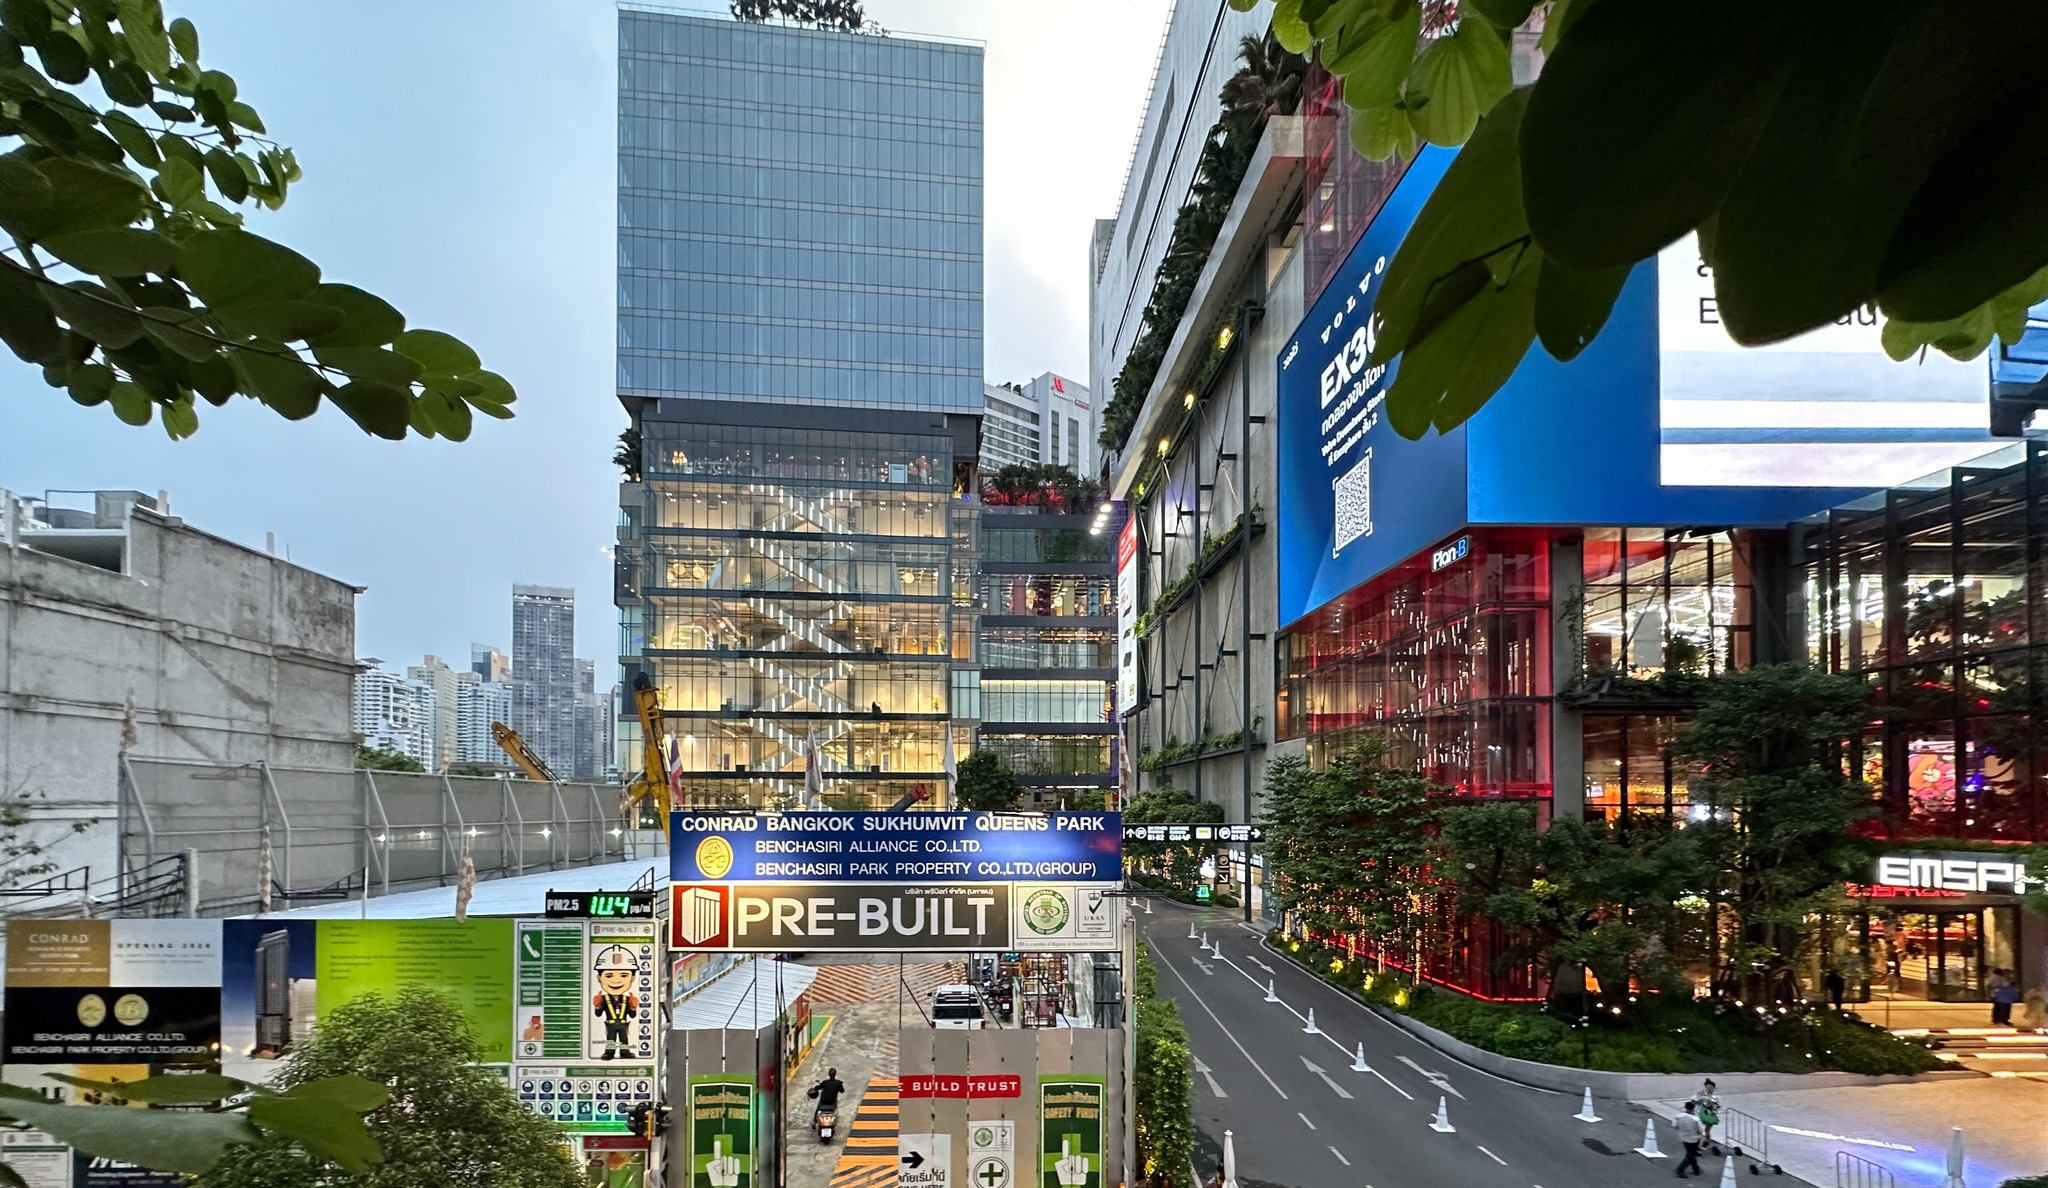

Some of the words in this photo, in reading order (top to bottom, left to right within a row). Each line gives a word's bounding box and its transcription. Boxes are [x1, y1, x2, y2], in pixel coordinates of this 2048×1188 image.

[1320, 255, 1386, 345] VOLVO
[1366, 388, 1386, 413] Store
[1371, 412, 1378, 426] 2
[681, 816, 758, 832] CONRAD
[766, 816, 855, 832] BANGKOK
[863, 816, 968, 832] SUKHUMVIT
[975, 815, 1049, 832] QUEENS
[1056, 816, 1105, 831] PARK
[755, 840, 842, 853] BENCHASIRI
[849, 840, 918, 853] ALLIANCE
[925, 840, 983, 854] CO.,LTD.
[755, 863, 842, 875] BENCHASIRI
[850, 863, 889, 875] PARK
[895, 862, 972, 875] PROPERTY
[546, 899, 580, 911] PM2.5
[737, 897, 995, 936] PRE-BUILT
[29, 933, 90, 944] CONRAD
[912, 1081, 960, 1091] BUILD
[967, 1081, 1018, 1091] TRUST
[695, 1107, 726, 1120] SAFETY
[728, 1107, 750, 1120] FIRST
[1044, 1107, 1073, 1119] SAFETY
[1075, 1106, 1100, 1119] FIRST
